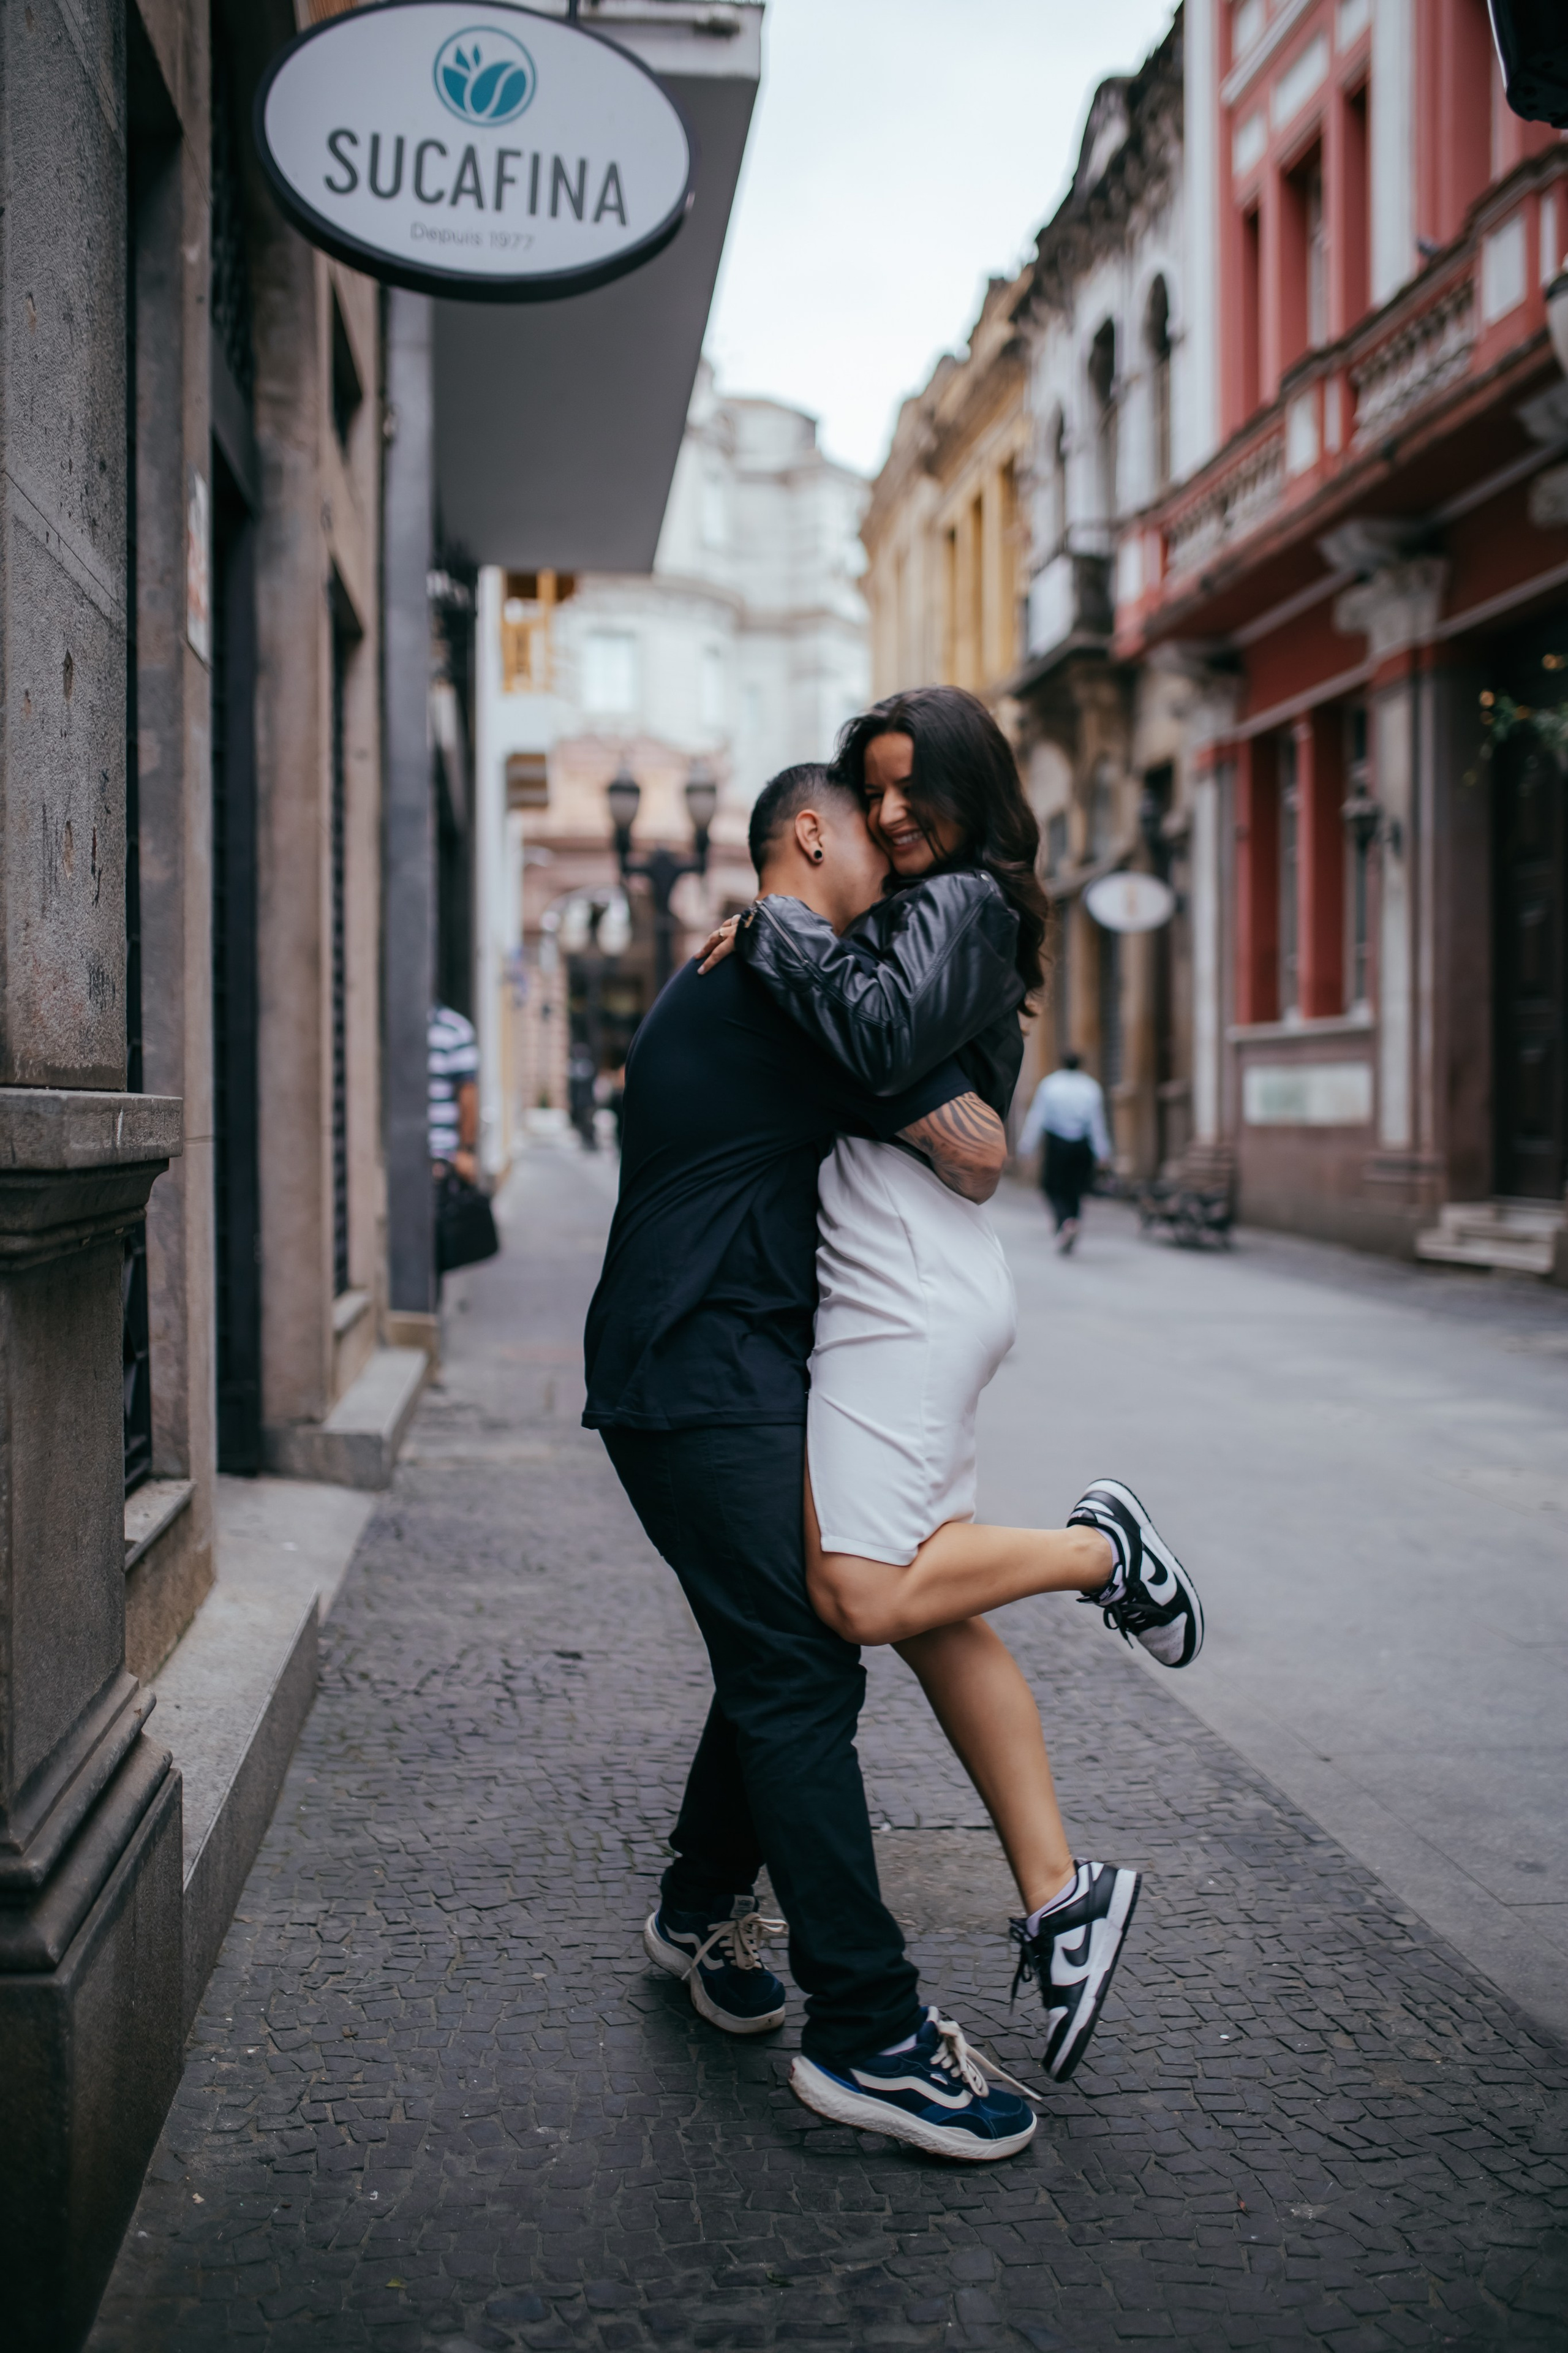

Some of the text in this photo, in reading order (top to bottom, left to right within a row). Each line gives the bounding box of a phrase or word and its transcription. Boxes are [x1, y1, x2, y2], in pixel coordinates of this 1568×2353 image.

[324, 127, 628, 227] SUCAFINA
[410, 221, 535, 252] Depuis 1977
